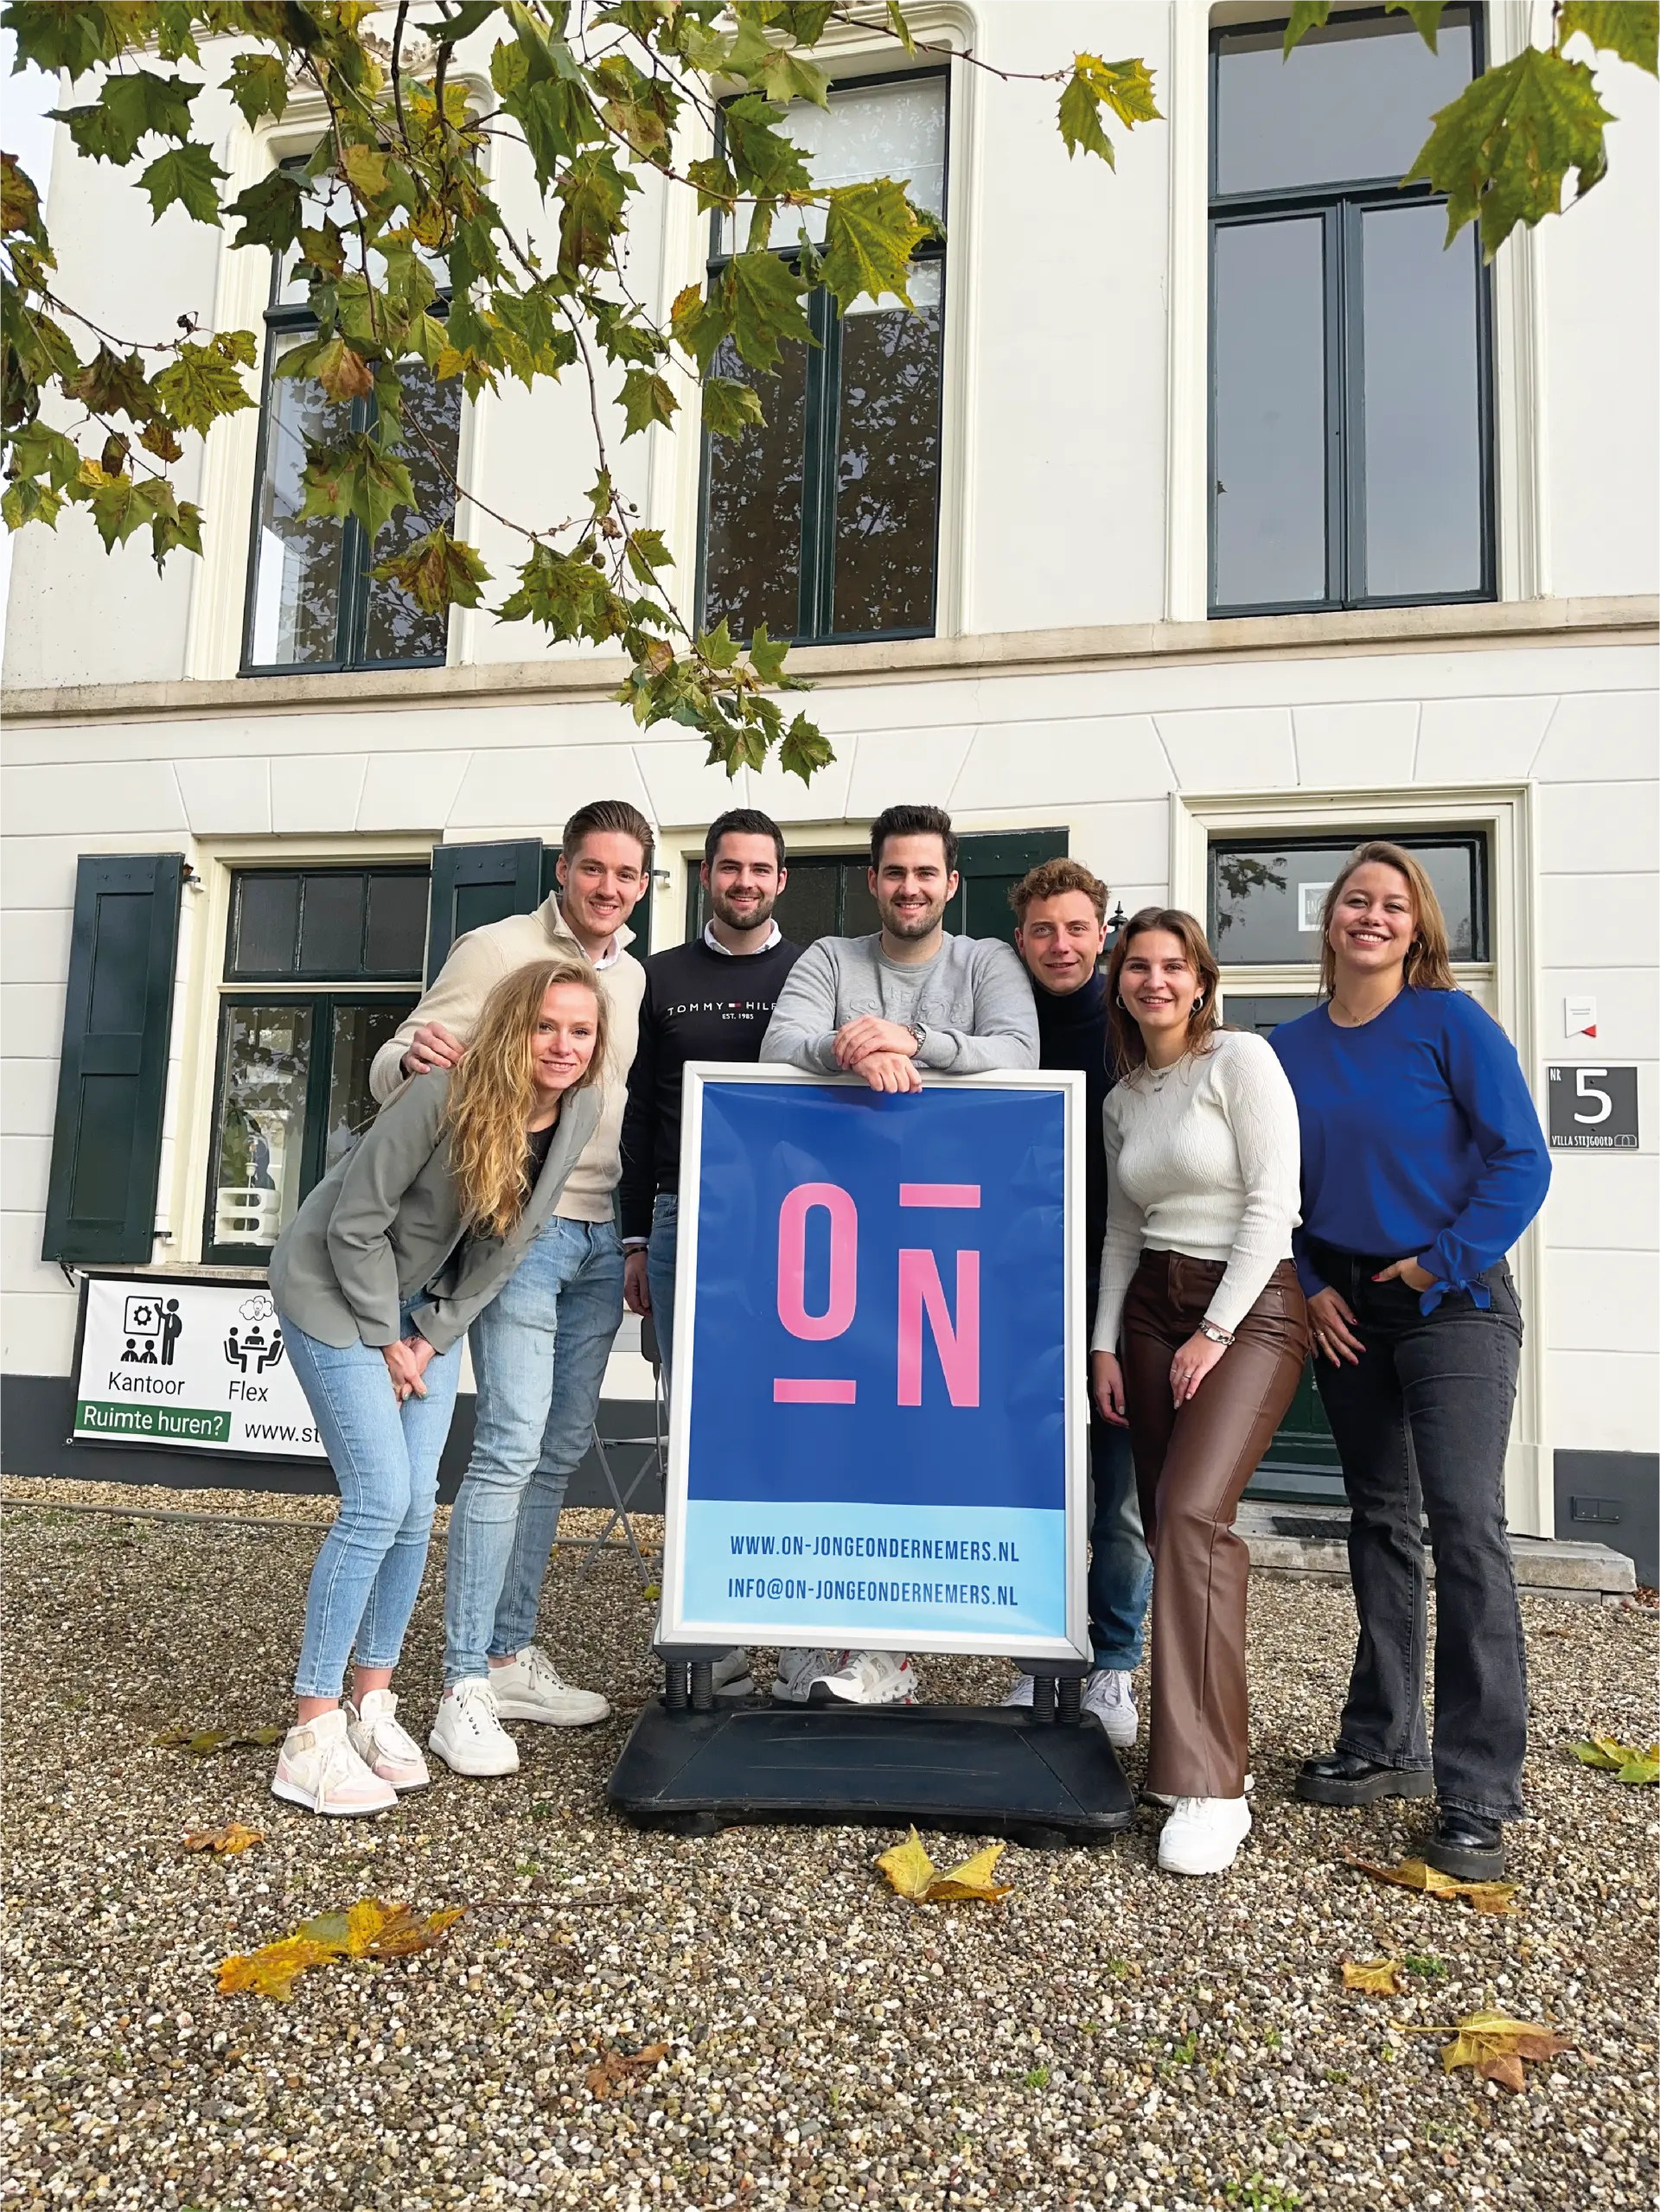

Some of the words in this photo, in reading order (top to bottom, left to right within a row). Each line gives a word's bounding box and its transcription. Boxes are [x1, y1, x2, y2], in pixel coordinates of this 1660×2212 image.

[667, 1002, 724, 1016] TOMMY
[1549, 1068, 1561, 1081] NR
[1574, 1068, 1612, 1124] 5
[1551, 1135, 1573, 1146] VILLA
[108, 1371, 185, 1395] Kantoor
[228, 1380, 269, 1402] Flex
[84, 1405, 153, 1431] Ruimte
[158, 1411, 223, 1436] huren?
[730, 1535, 1020, 1562] WWW.ON-JONGEONDERNEMERS.NL
[728, 1578, 1018, 1606] INFO@ON-JONGEONDERNEMERS.NL
